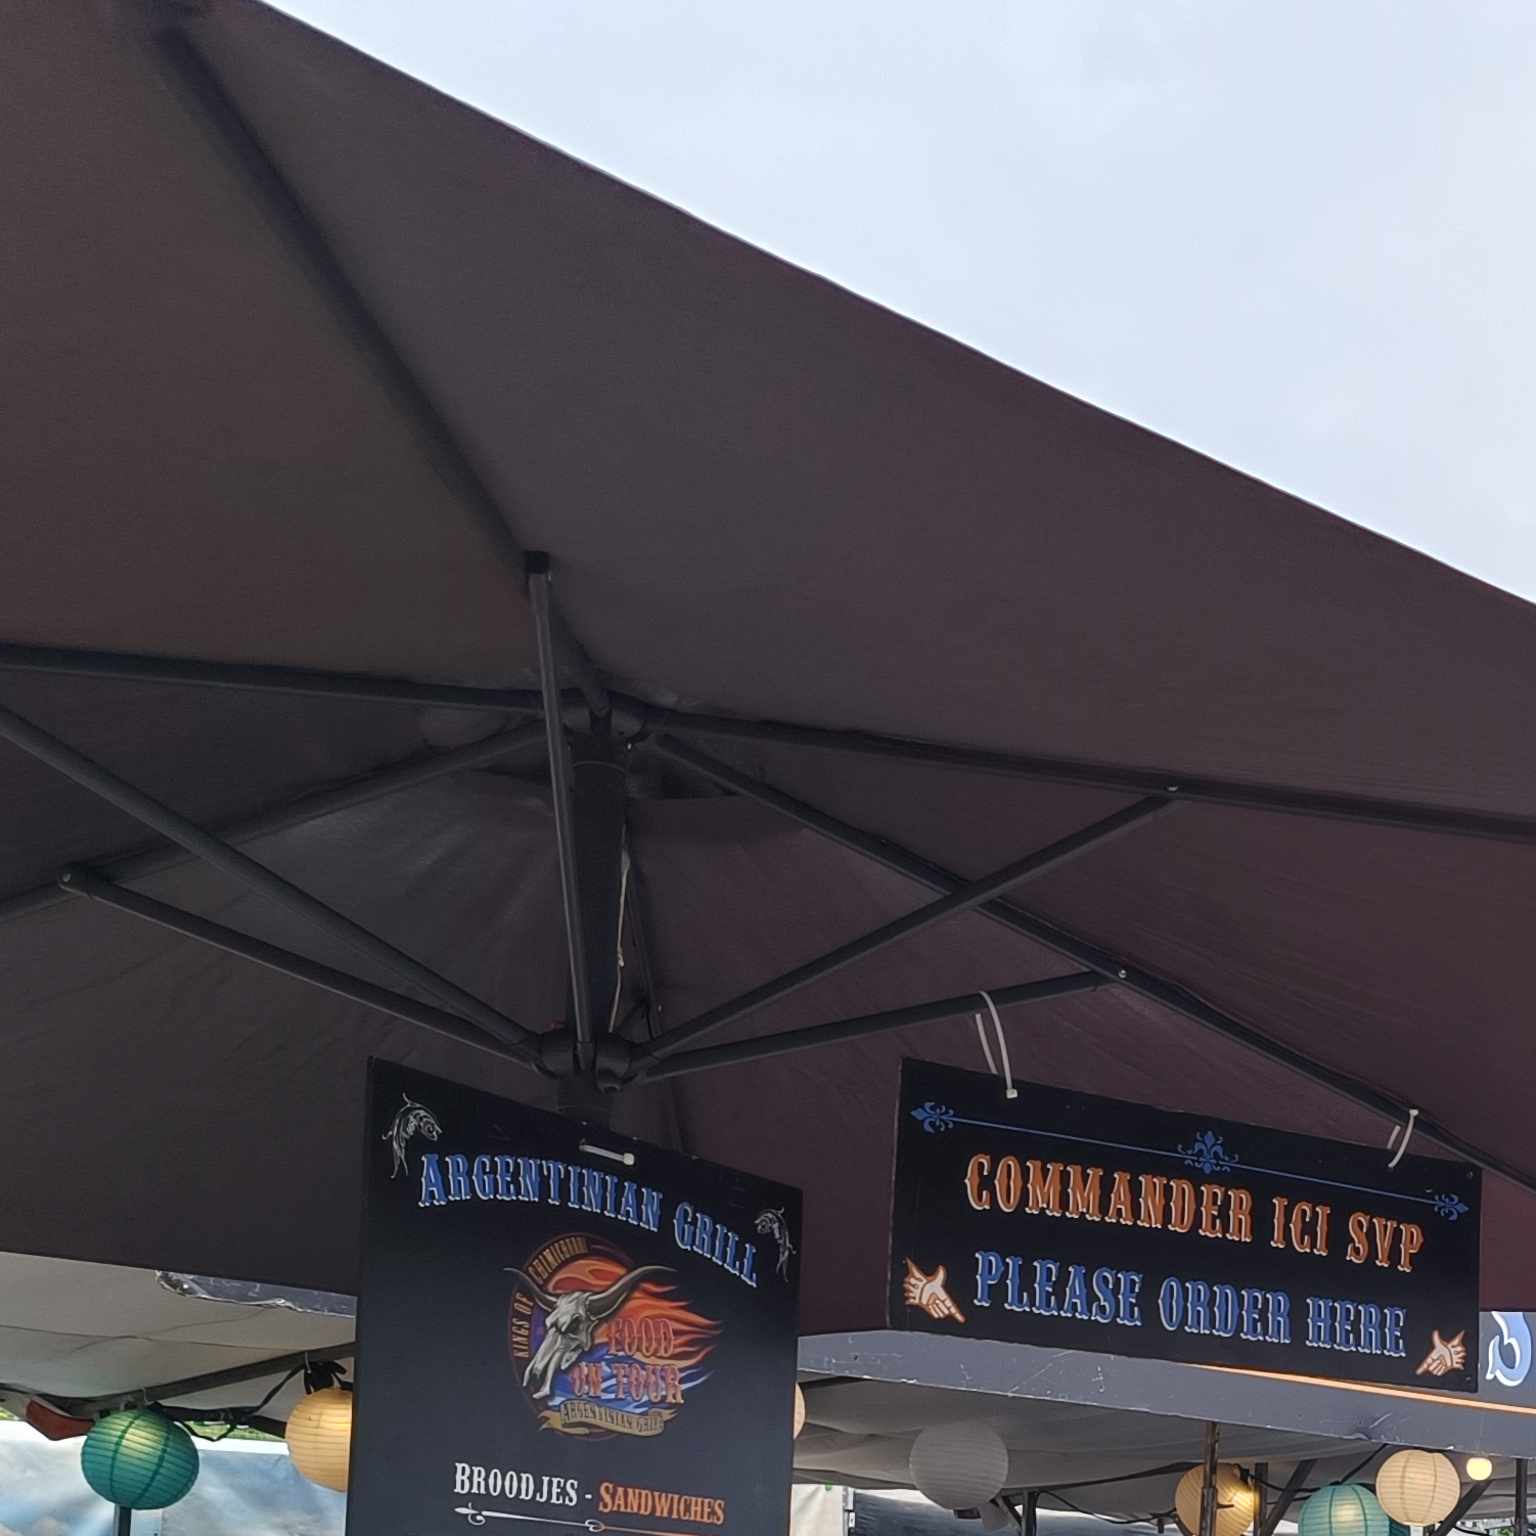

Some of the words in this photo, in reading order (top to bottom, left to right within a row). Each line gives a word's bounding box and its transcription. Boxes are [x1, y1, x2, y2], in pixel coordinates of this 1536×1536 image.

[418, 1152, 663, 1233] ARGENTINIAN
[673, 1201, 757, 1287] GRILL
[965, 1153, 1254, 1242] COMMANDER
[1271, 1197, 1332, 1256] ICI
[1346, 1212, 1424, 1273] SVP
[973, 1251, 1143, 1327] PLEASE
[1158, 1276, 1292, 1345] ORDER
[1306, 1296, 1407, 1358] HERE
[453, 1462, 579, 1506] BROODJES
[599, 1482, 725, 1525] SANDWICHES
